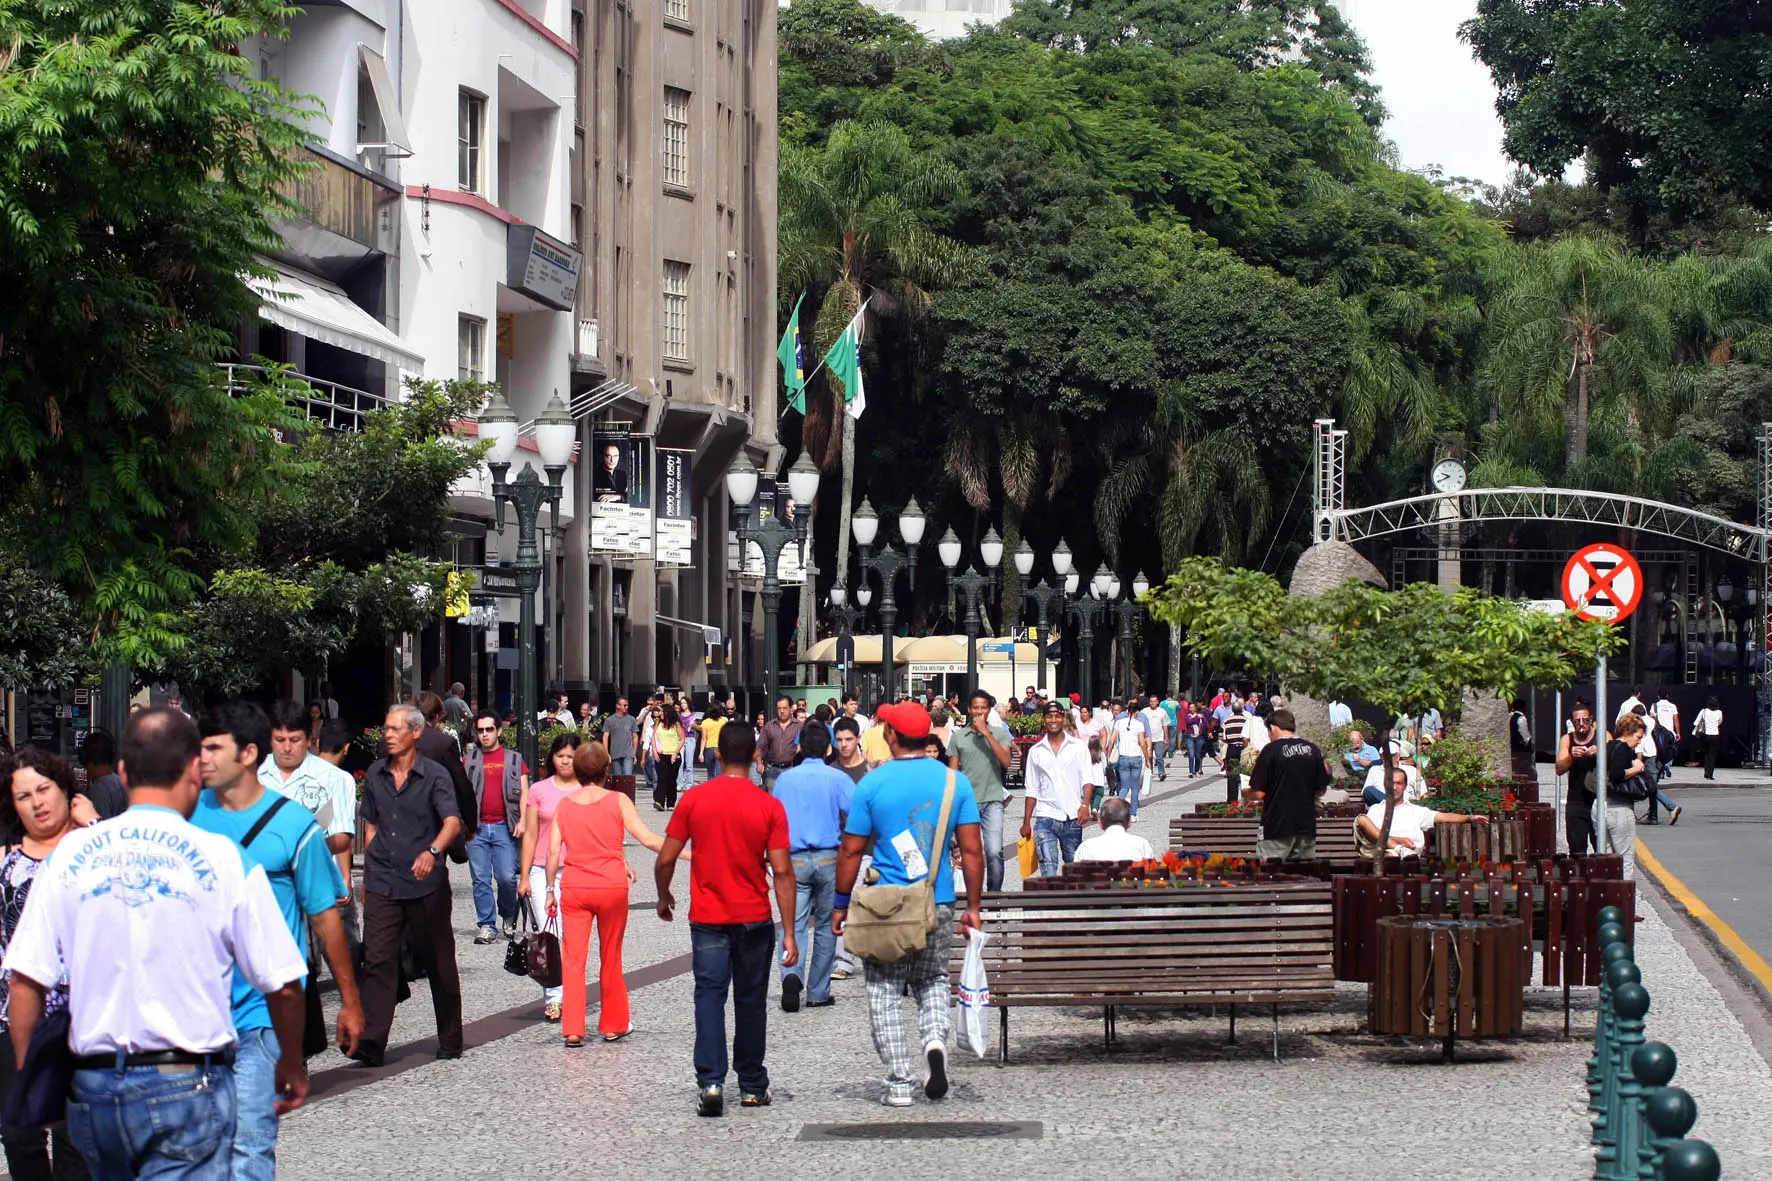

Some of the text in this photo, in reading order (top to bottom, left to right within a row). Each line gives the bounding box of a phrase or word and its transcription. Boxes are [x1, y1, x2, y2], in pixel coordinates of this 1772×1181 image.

[666, 454, 675, 517] 0800 702 0501
[68, 830, 112, 876] ABOUT
